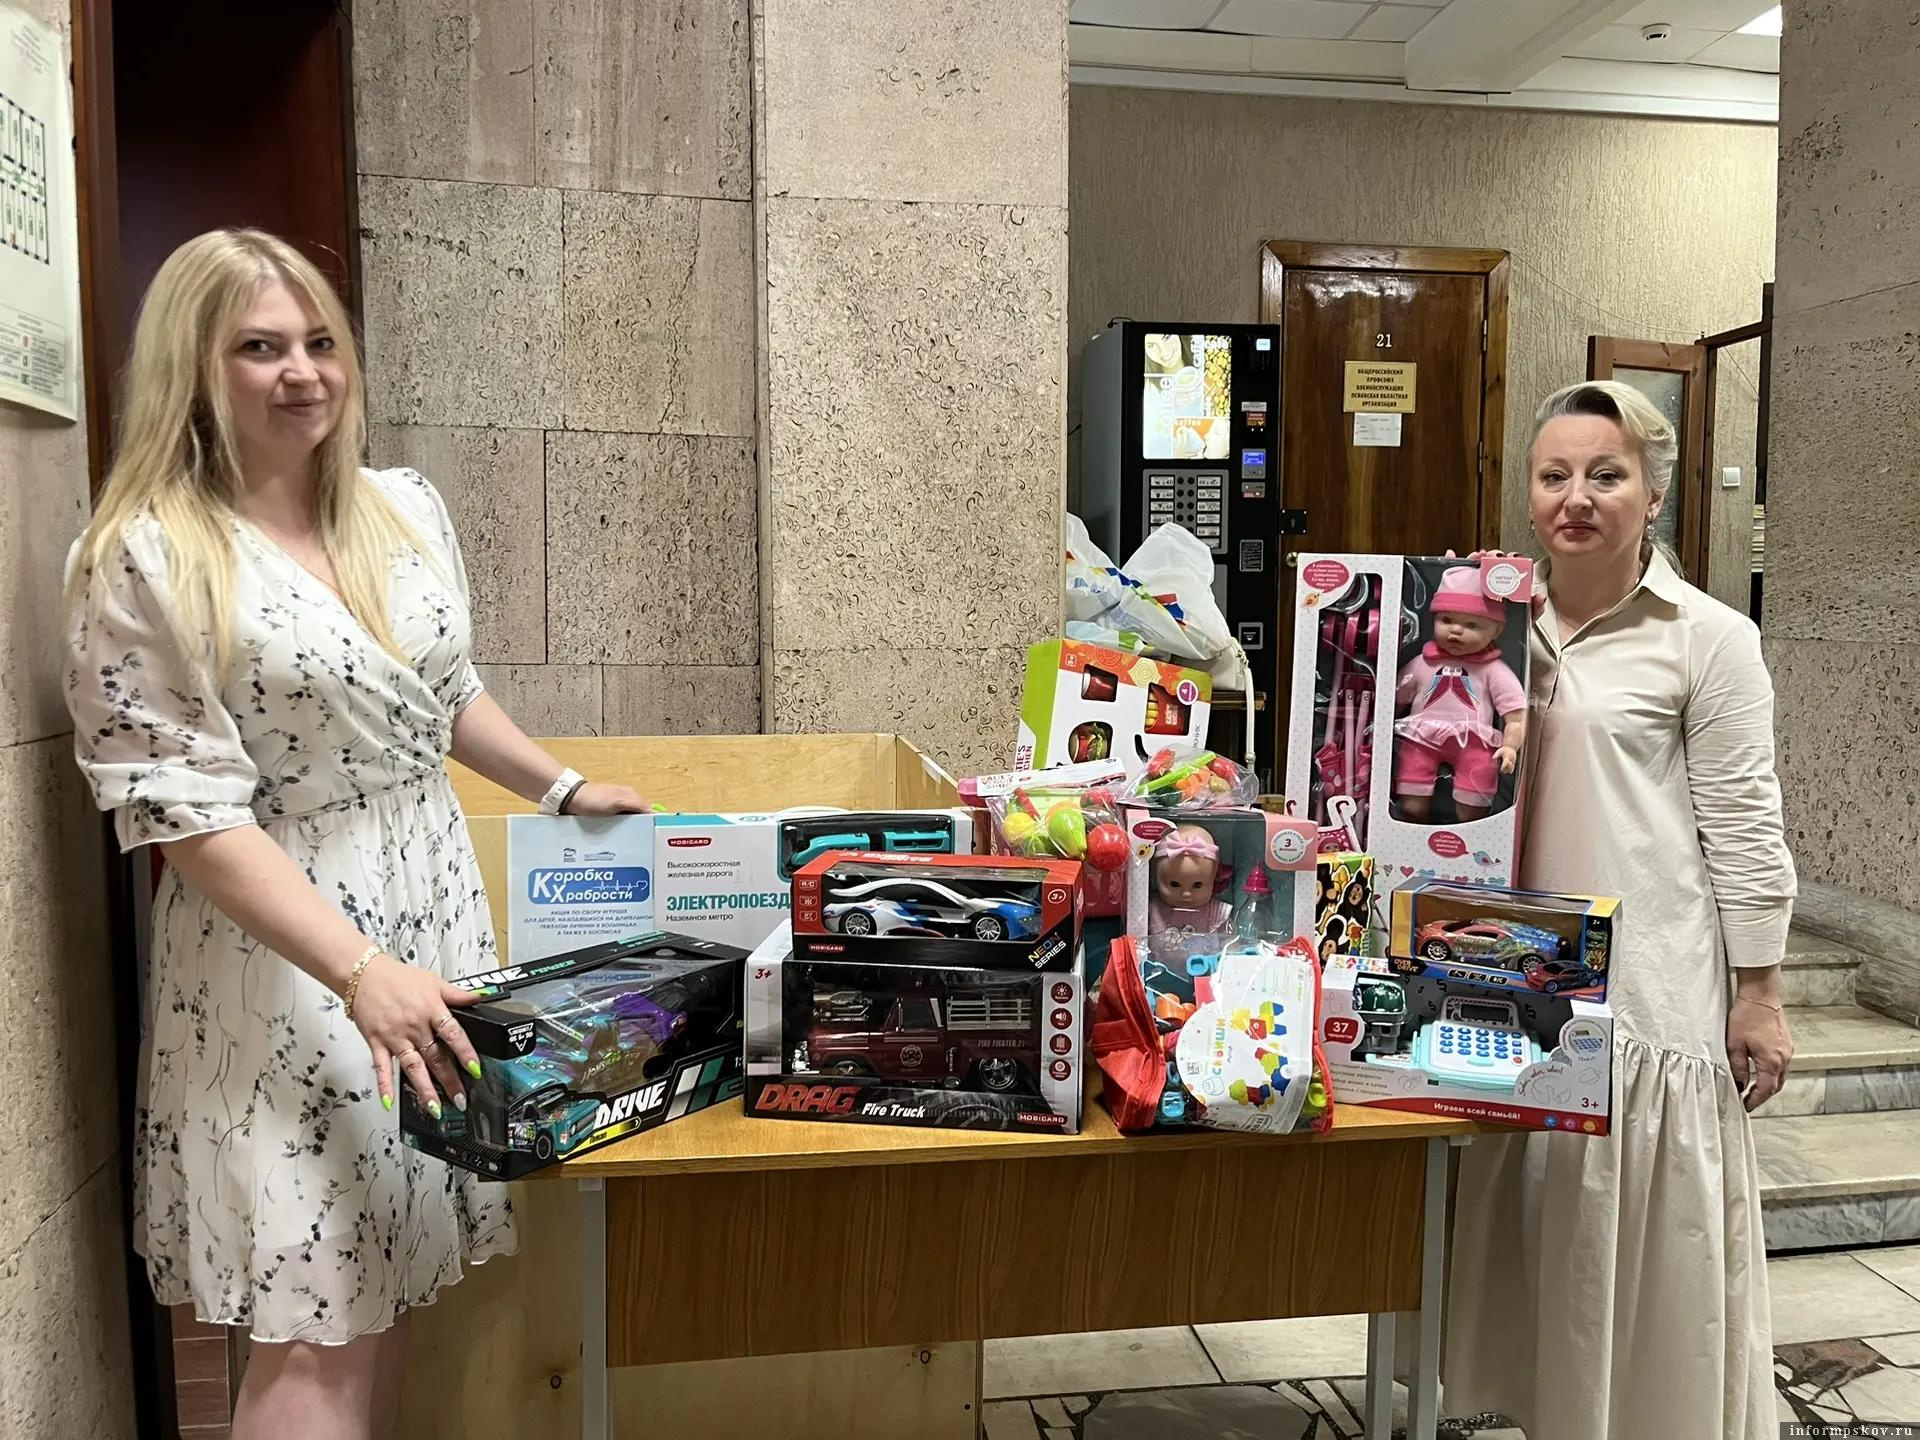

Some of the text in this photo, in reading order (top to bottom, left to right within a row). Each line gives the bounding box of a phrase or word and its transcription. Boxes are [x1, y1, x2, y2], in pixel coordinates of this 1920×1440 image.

[1376, 333, 1392, 347] 21
[1357, 368, 1403, 376] ОБЩЕРОССИЙСКИЙ
[1016, 745, 1026, 772] TIE'S
[1024, 745, 1032, 770] CHEN
[1284, 838, 1291, 847] 3
[533, 869, 614, 898] Коробка
[550, 884, 632, 903] Храбрости
[667, 893, 791, 911] ЭЛЕКТРОПОЕЗД
[1051, 892, 1063, 900] 3+
[709, 913, 733, 921] метро
[1028, 931, 1061, 963] NEON
[1034, 940, 1066, 969] SERIES
[450, 966, 529, 992] RIVE
[755, 968, 772, 979] 3+
[1333, 1021, 1349, 1033] 37
[593, 1080, 668, 1130] DRIVE
[755, 1083, 863, 1114] DRAG
[1434, 1102, 1465, 1112] Играем
[1581, 1098, 1599, 1109] 3+
[861, 1103, 926, 1119] Fire Truck
